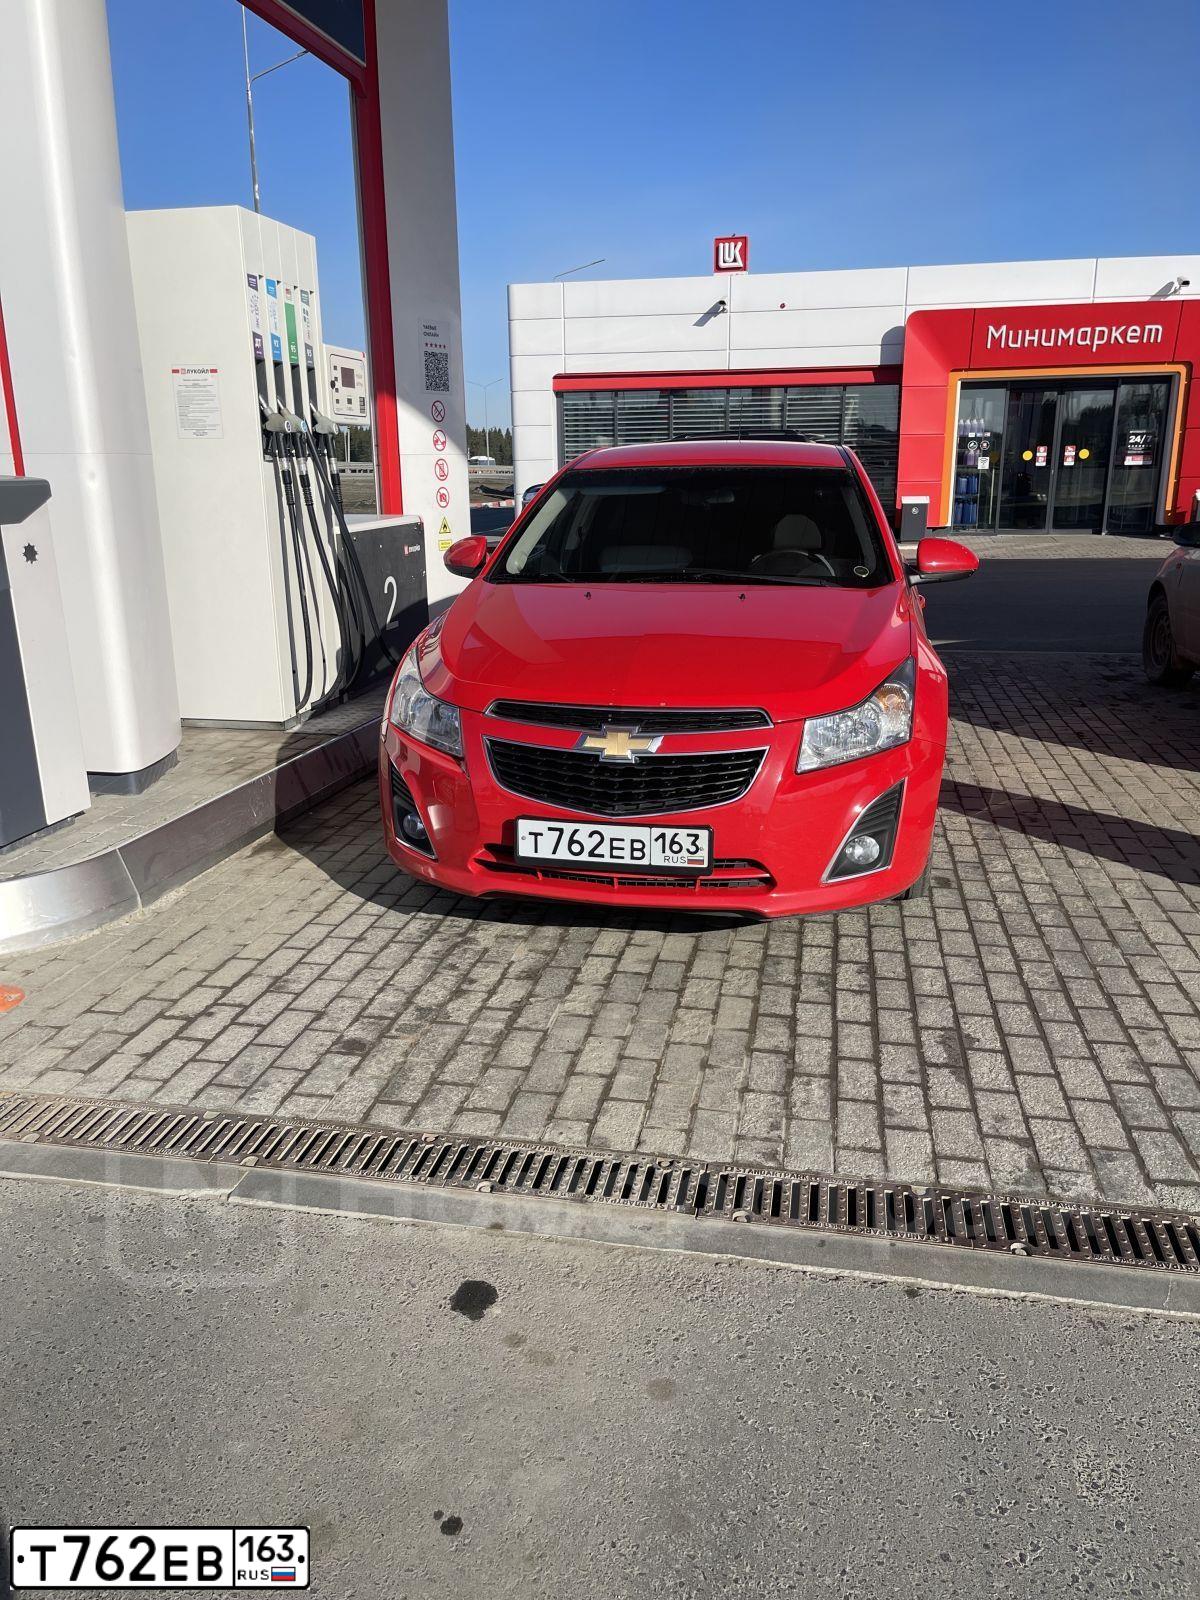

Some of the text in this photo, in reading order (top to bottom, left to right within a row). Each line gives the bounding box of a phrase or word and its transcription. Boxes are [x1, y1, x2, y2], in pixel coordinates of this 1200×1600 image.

[986, 324, 1163, 352] Минимаркет
[1128, 434, 1153, 445] 24/7
[384, 575, 399, 631] 2
[654, 832, 700, 855] 163
[664, 855, 687, 864] RUS
[735, 1166, 808, 1180] STANDARTPARK
